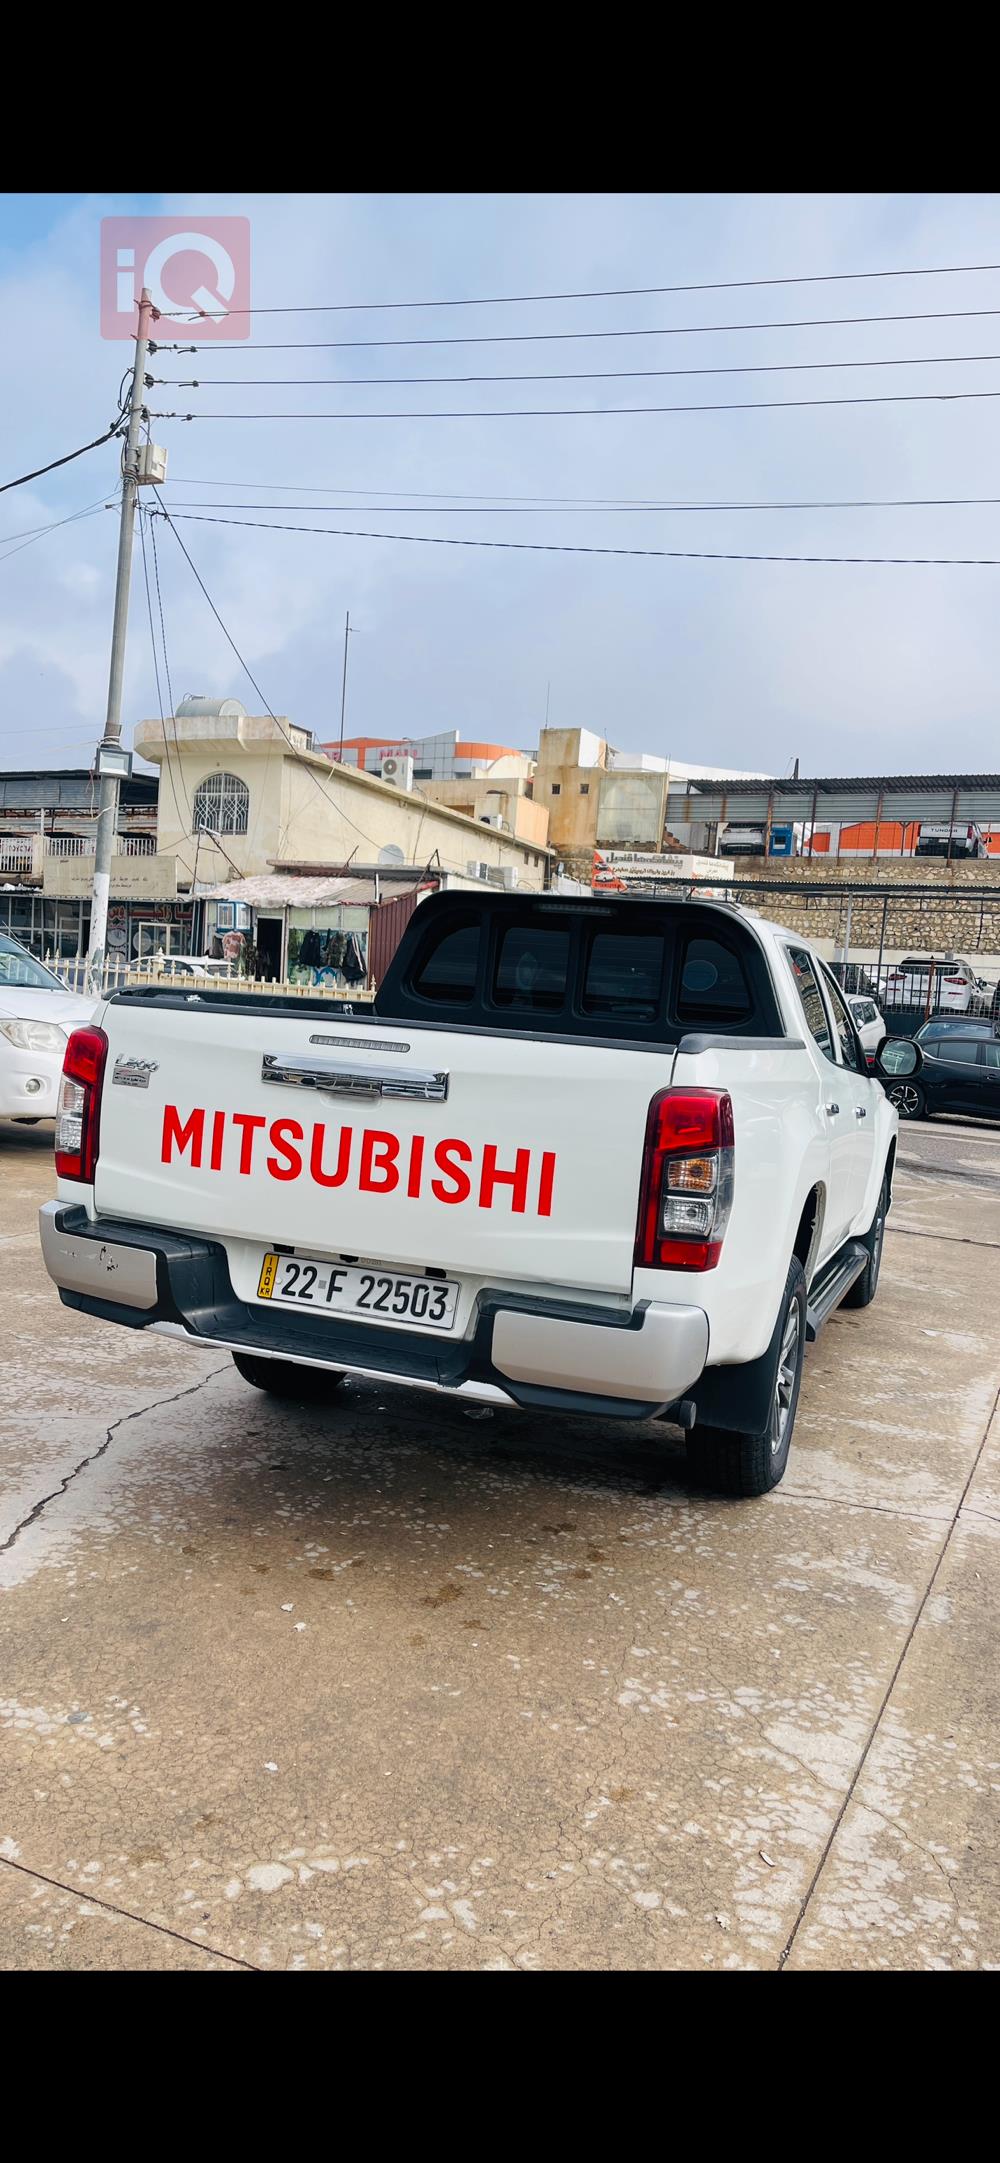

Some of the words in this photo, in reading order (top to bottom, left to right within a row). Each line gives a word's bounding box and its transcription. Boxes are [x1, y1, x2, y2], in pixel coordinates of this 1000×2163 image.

[161, 1105, 556, 1217] MITSUBISHI
[281, 1263, 318, 1300] 22
[326, 1270, 348, 1303] F
[356, 1275, 450, 1321] 22503
